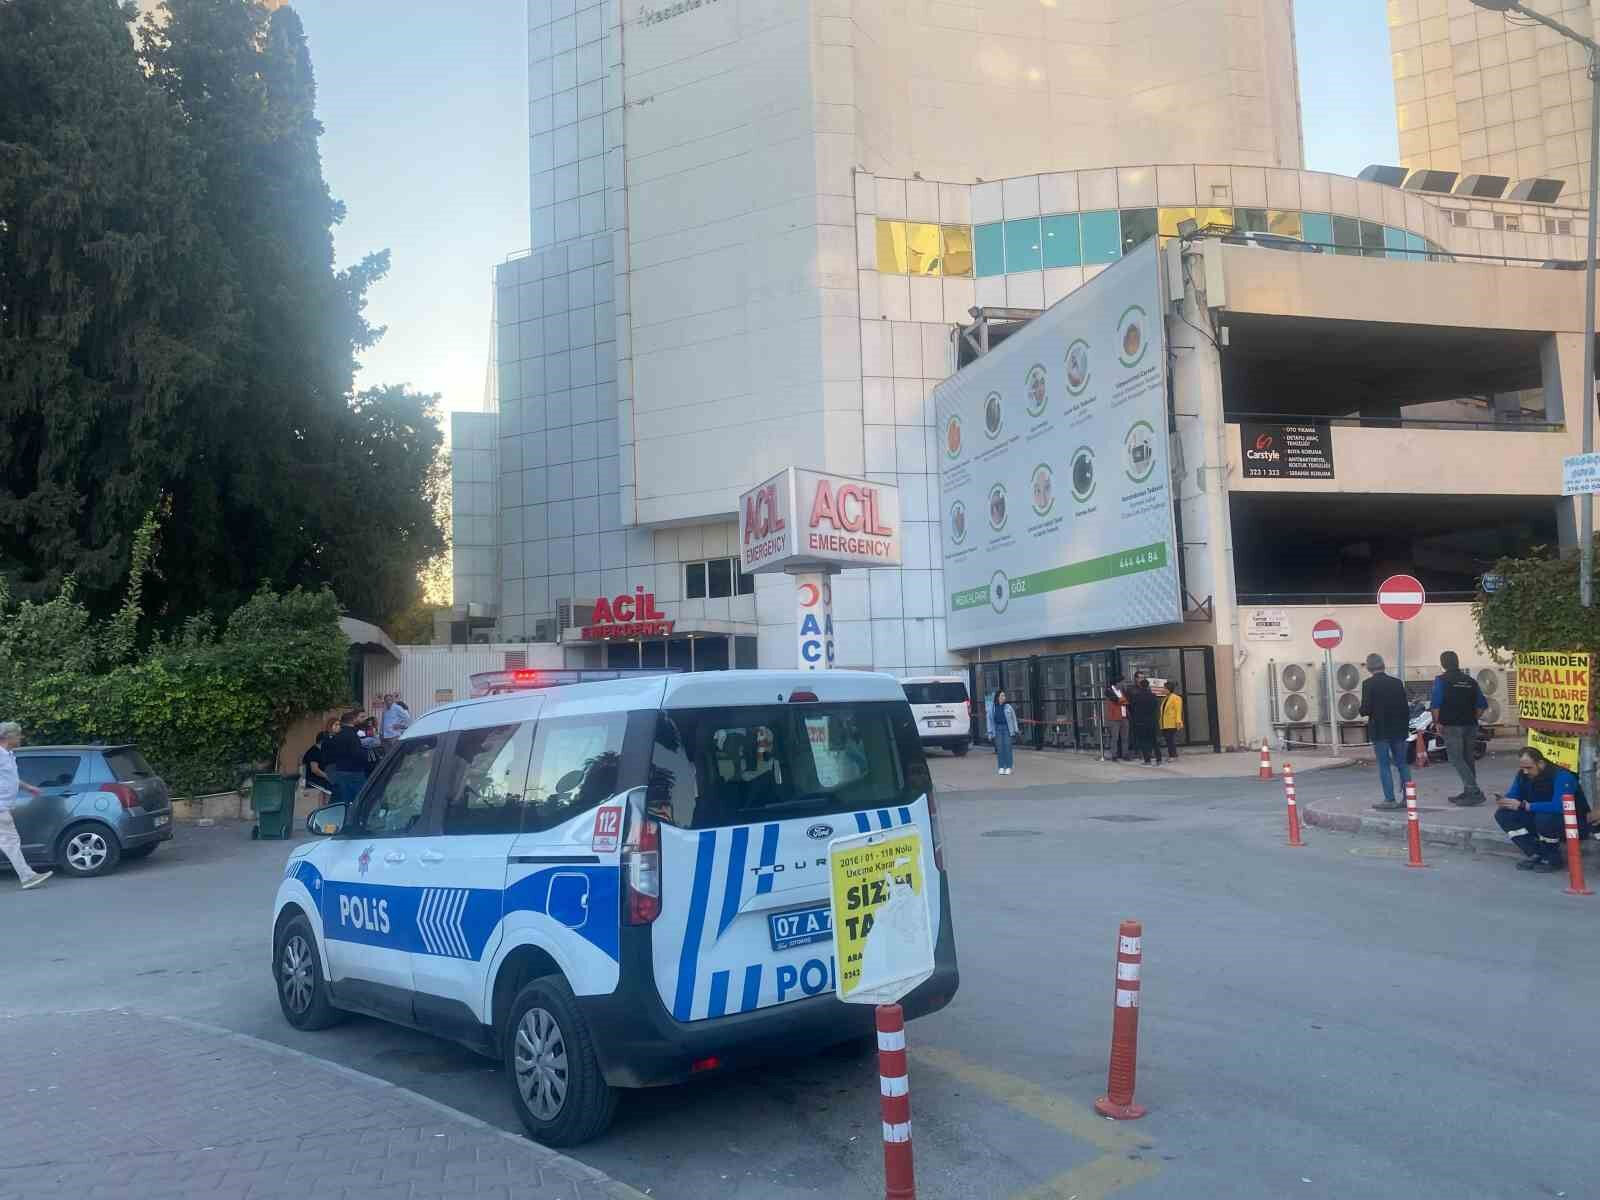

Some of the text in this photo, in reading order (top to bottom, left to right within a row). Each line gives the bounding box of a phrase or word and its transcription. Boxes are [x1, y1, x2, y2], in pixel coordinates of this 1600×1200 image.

[1246, 449, 1280, 461] Carstyle
[746, 534, 786, 564] EMERGENCY
[809, 533, 892, 557] EMERGENCY
[1541, 701, 1557, 719] 622
[1559, 703, 1571, 720] 32
[1573, 704, 1585, 721] 82
[600, 811, 617, 833] 112
[777, 916, 800, 937] 07
[806, 914, 820, 932] A
